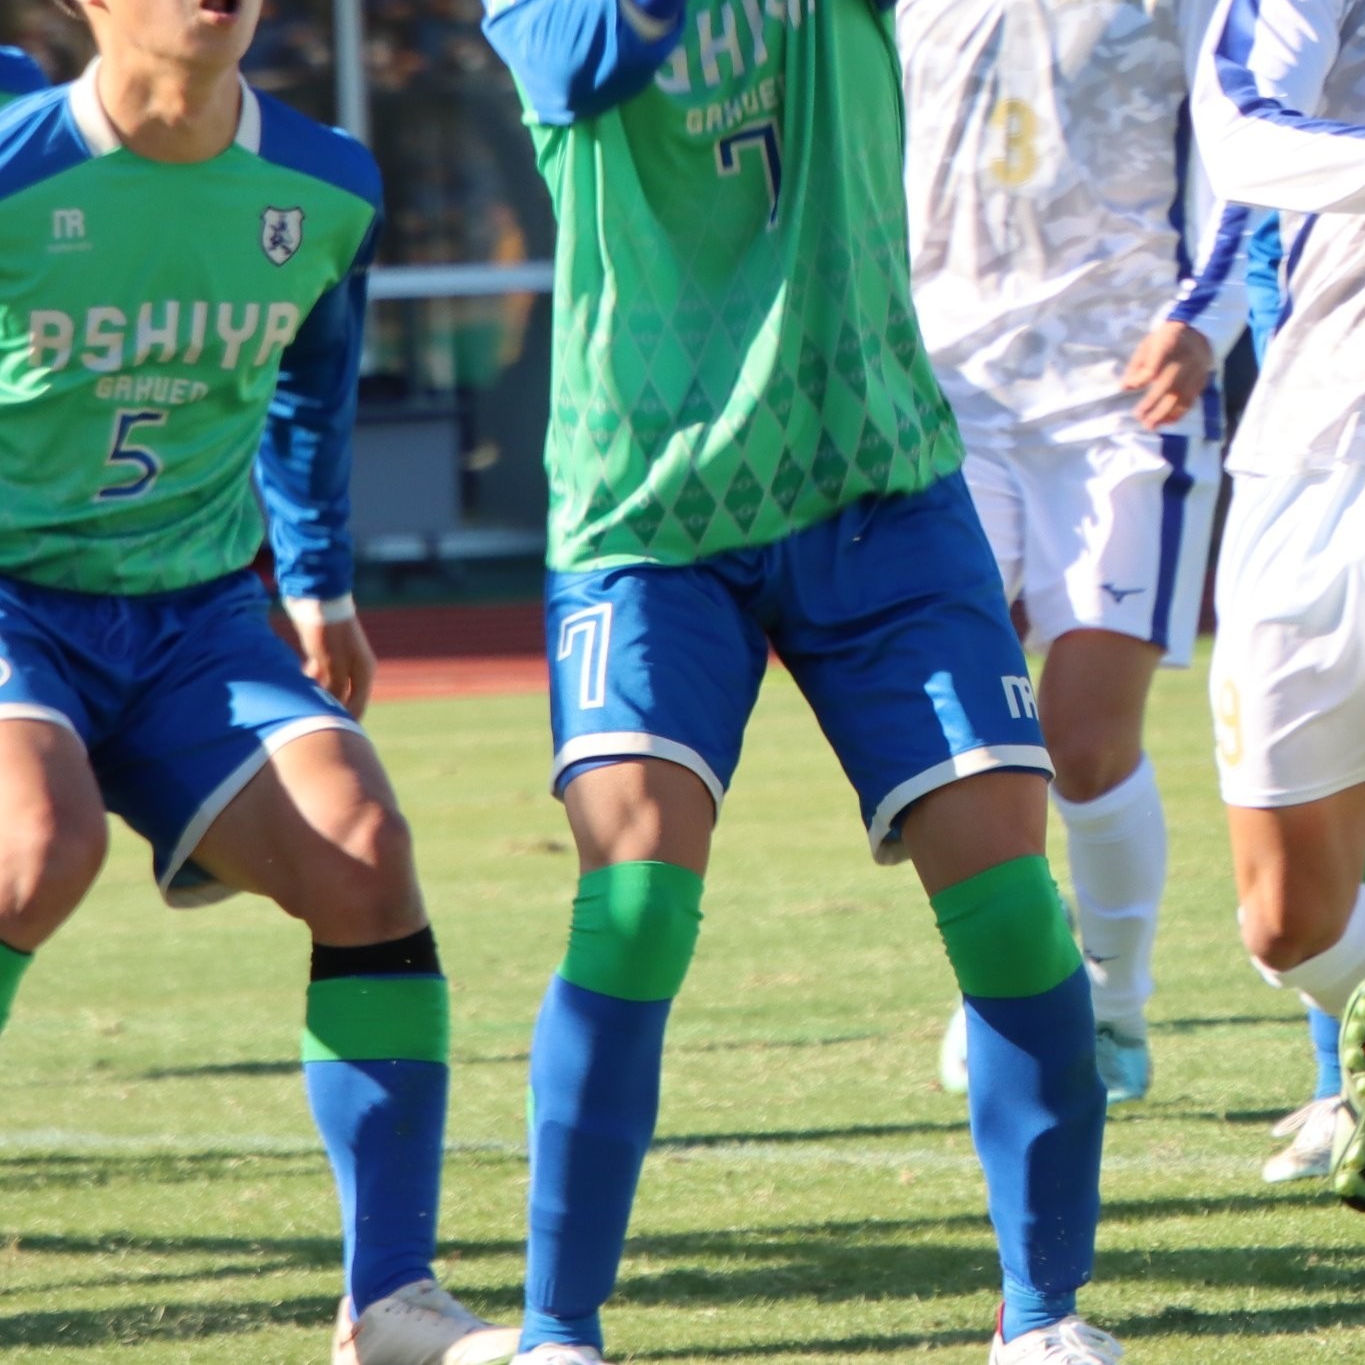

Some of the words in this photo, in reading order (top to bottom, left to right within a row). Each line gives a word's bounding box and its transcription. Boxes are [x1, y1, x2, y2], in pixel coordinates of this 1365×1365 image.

[714, 116, 784, 232] 7
[988, 98, 1039, 184] 3
[27, 300, 300, 373] ASHIYA
[92, 406, 170, 505] 5
[557, 602, 614, 710] 7
